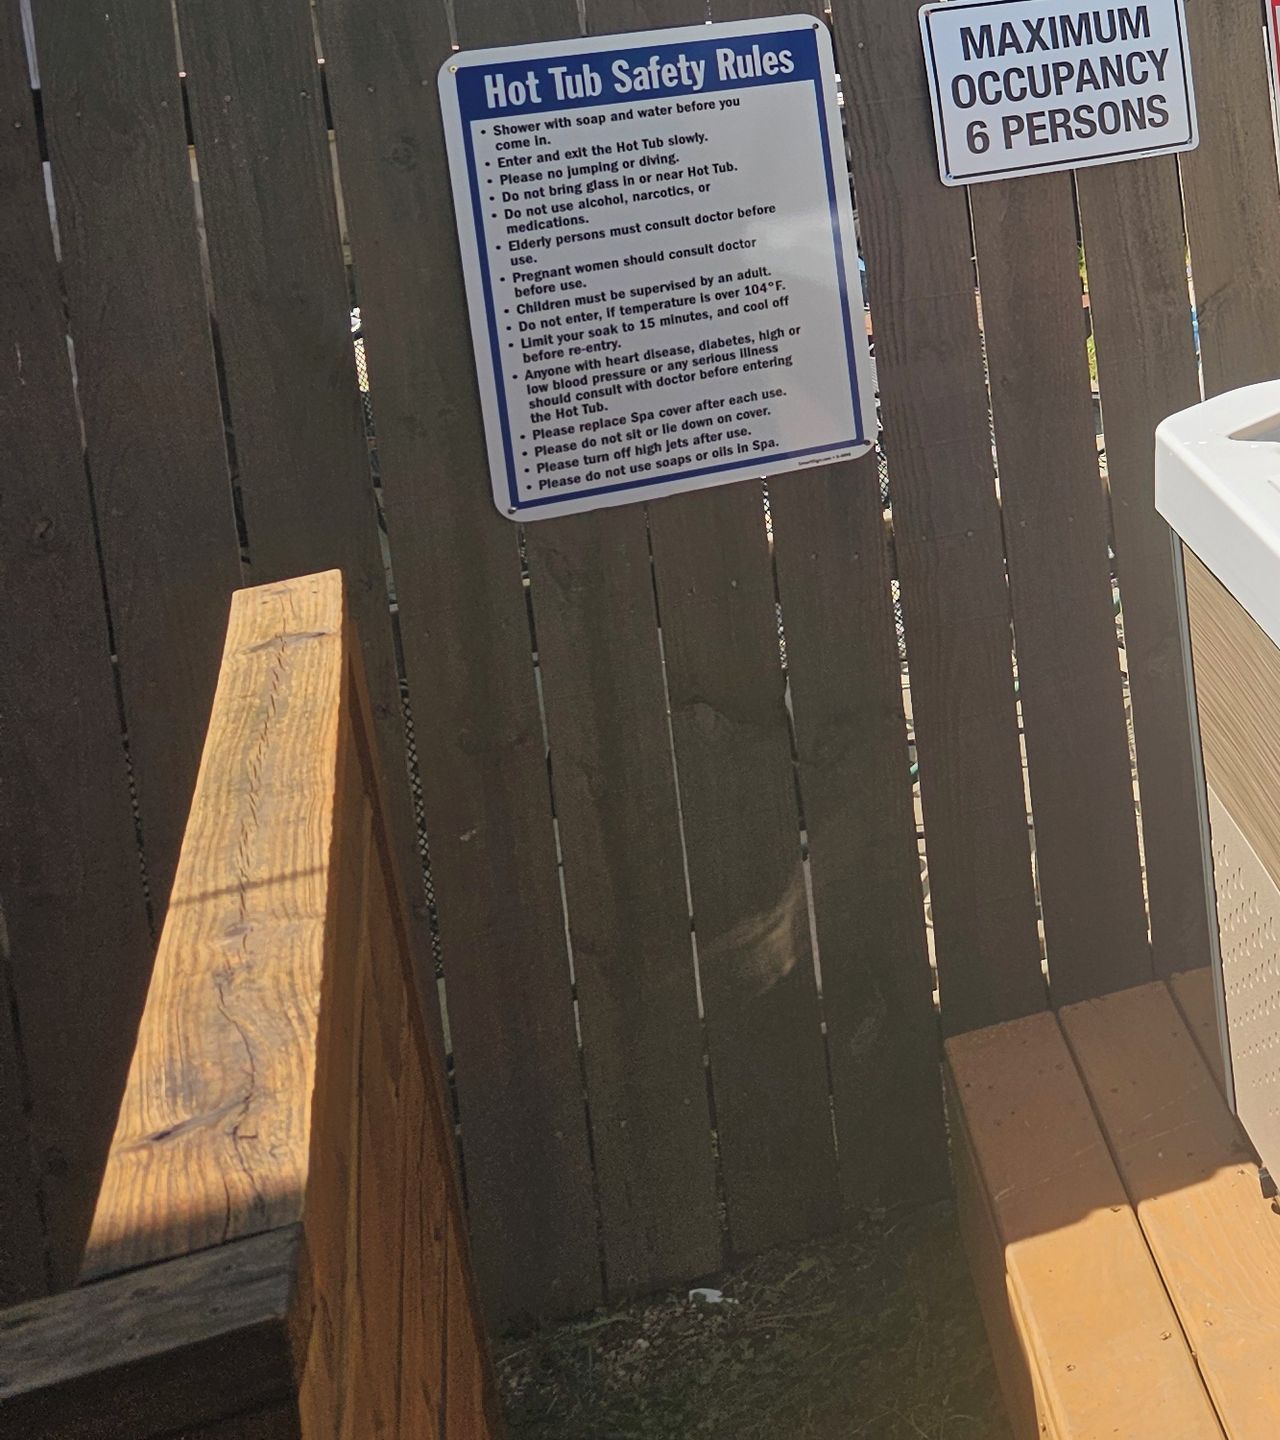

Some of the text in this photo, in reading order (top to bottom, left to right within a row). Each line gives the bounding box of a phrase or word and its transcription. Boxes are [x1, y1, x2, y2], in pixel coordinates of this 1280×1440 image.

[959, 5, 1150, 61] MAXIMUM
[484, 44, 794, 108] Hot Tub Safety Rules
[951, 47, 1169, 109] OCCUPANCY
[493, 97, 740, 136] Shower with soap and water before you
[966, 94, 1169, 154] 6 PERSONS
[495, 135, 551, 151] come in.
[497, 132, 708, 168] Enter and exit the Hot Tub slowly.
[499, 153, 680, 186] Please no jumping or diving.
[501, 161, 738, 203] Do not bring glass in or near Hot Tub.
[504, 183, 711, 220] Do not use alcohol, narcotics, or
[506, 215, 589, 235] medications.
[508, 204, 776, 252] Elderly persons must consult doctor before
[510, 255, 538, 266] use.
[512, 239, 757, 283] Pregnant women should consult doctor
[514, 279, 587, 298] before use.
[516, 266, 772, 315] Children must be supervised by an adult.
[518, 320, 536, 332] Do
[540, 315, 562, 329] not
[565, 311, 602, 324] enter,
[606, 306, 615, 318] if
[619, 296, 696, 316] temperature
[699, 292, 711, 303] is
[714, 289, 740, 301] over
[520, 295, 789, 349] Limit your soak to 15 minutes, and cool off
[522, 340, 621, 364] before re-entry.
[524, 326, 801, 381] Anyone with heart disease, diabetes, high or
[526, 344, 778, 395] low blood pressure or any serious illness
[528, 354, 793, 409] should consult with doctor before entering
[530, 402, 608, 424] the Hot Tub.
[532, 388, 787, 440] Please replace Spa cover after each use.
[534, 407, 771, 457] Please do not sit or lie down on cover.
[536, 427, 751, 474] Please turn off high jets after use.
[538, 439, 779, 491] Please do not use soaps or oils in Spa.
